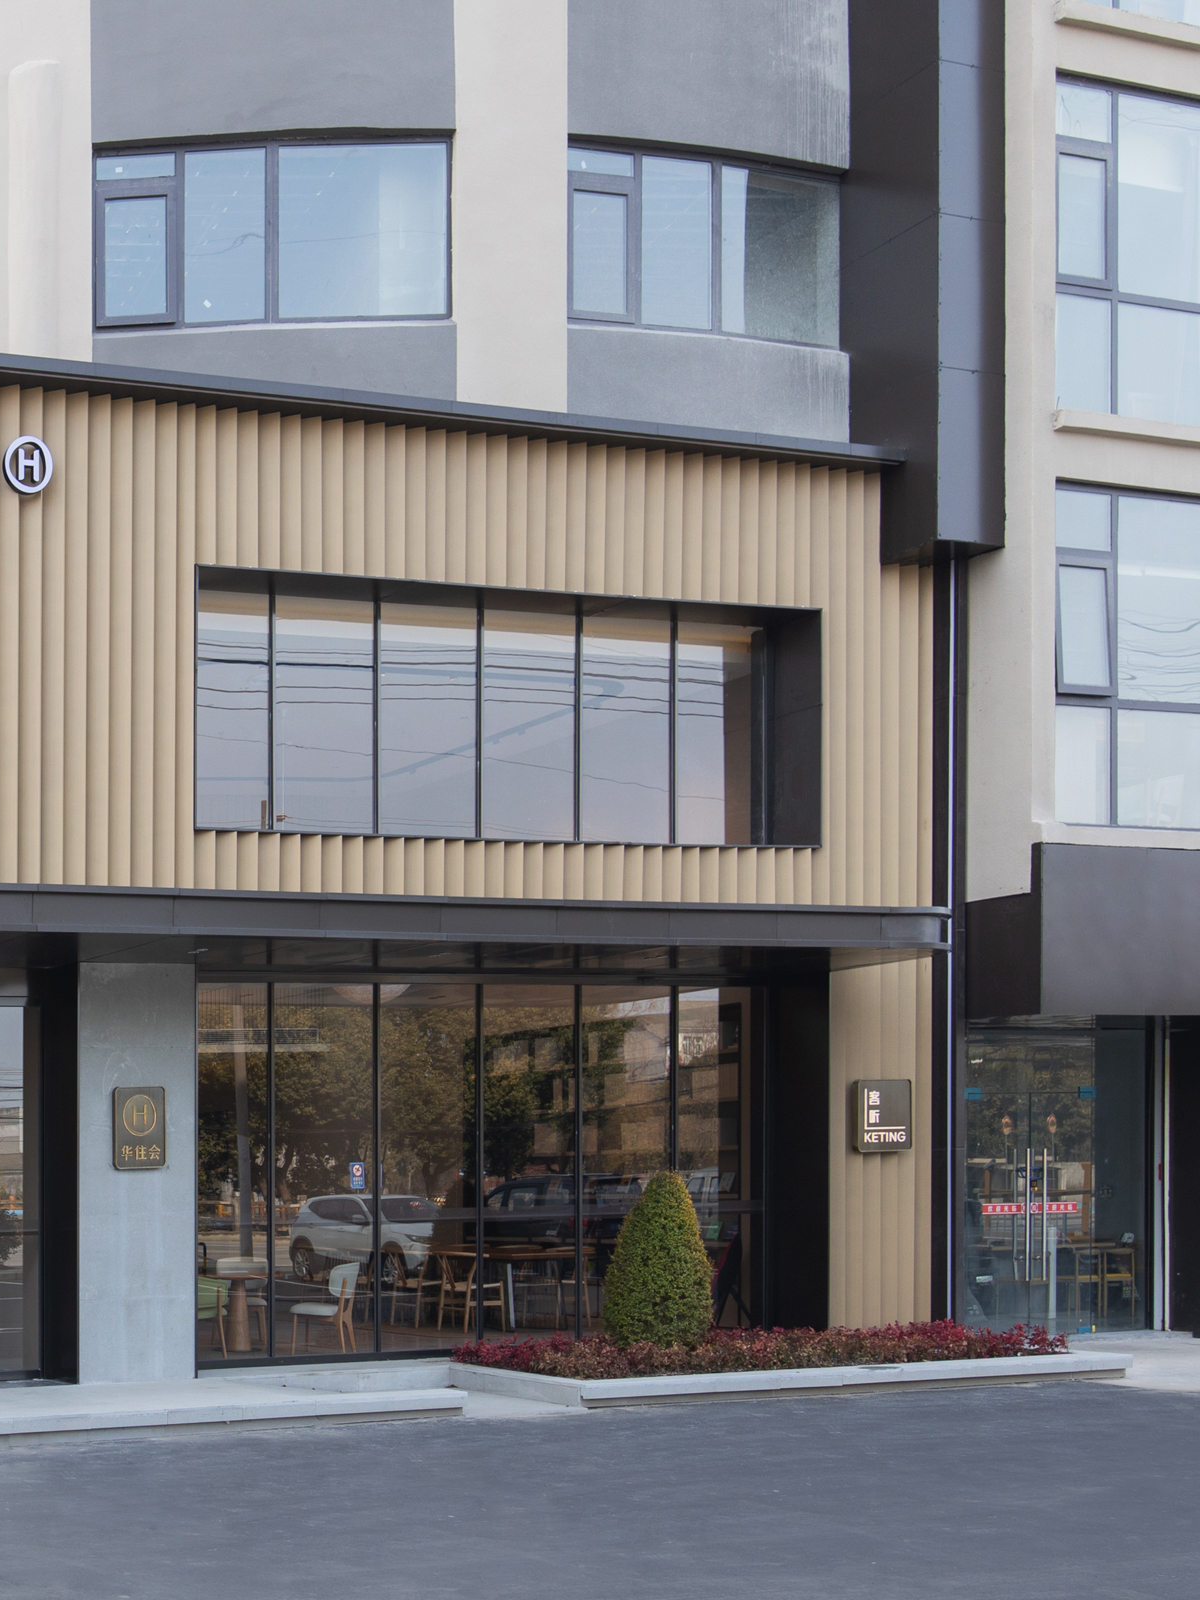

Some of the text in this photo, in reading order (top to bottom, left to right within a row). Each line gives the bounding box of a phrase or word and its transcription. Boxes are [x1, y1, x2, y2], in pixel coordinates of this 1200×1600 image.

[863, 1131, 907, 1143] KETING
[120, 1144, 161, 1161] 华住会
